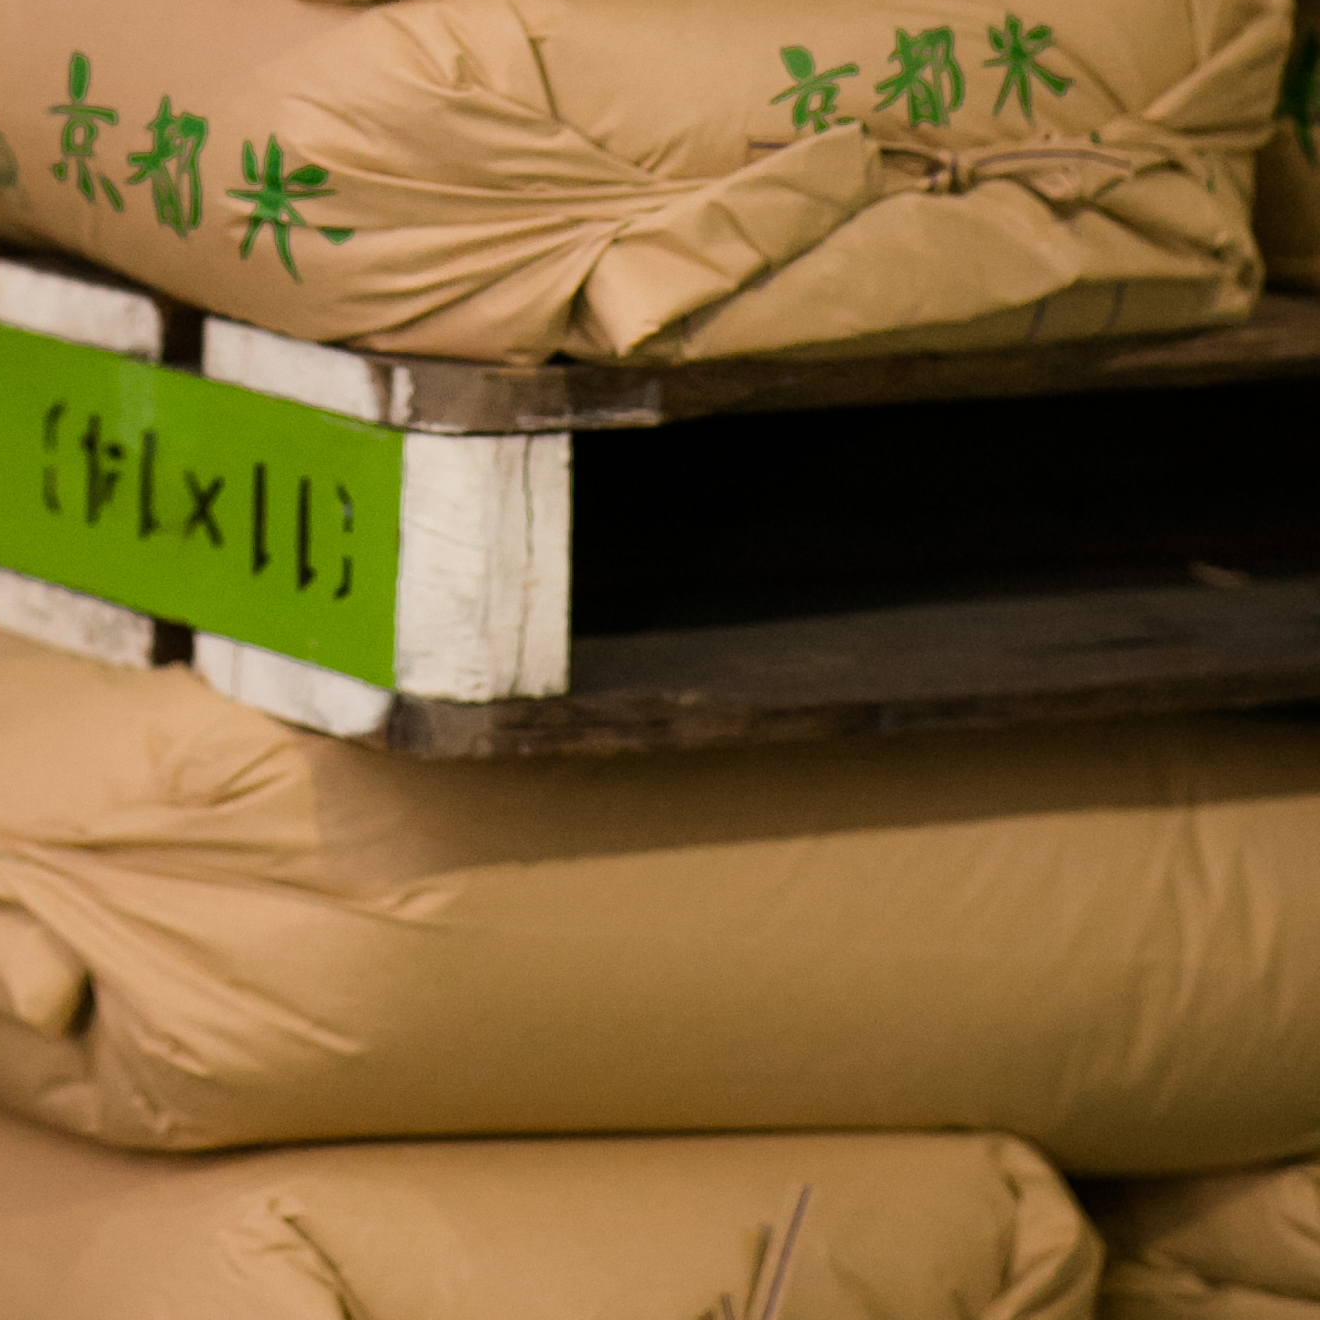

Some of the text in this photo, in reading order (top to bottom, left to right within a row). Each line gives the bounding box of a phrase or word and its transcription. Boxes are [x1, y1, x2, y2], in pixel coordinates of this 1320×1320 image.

[770, 14, 1075, 134] 京都米
[52, 50, 355, 280] 京都米
